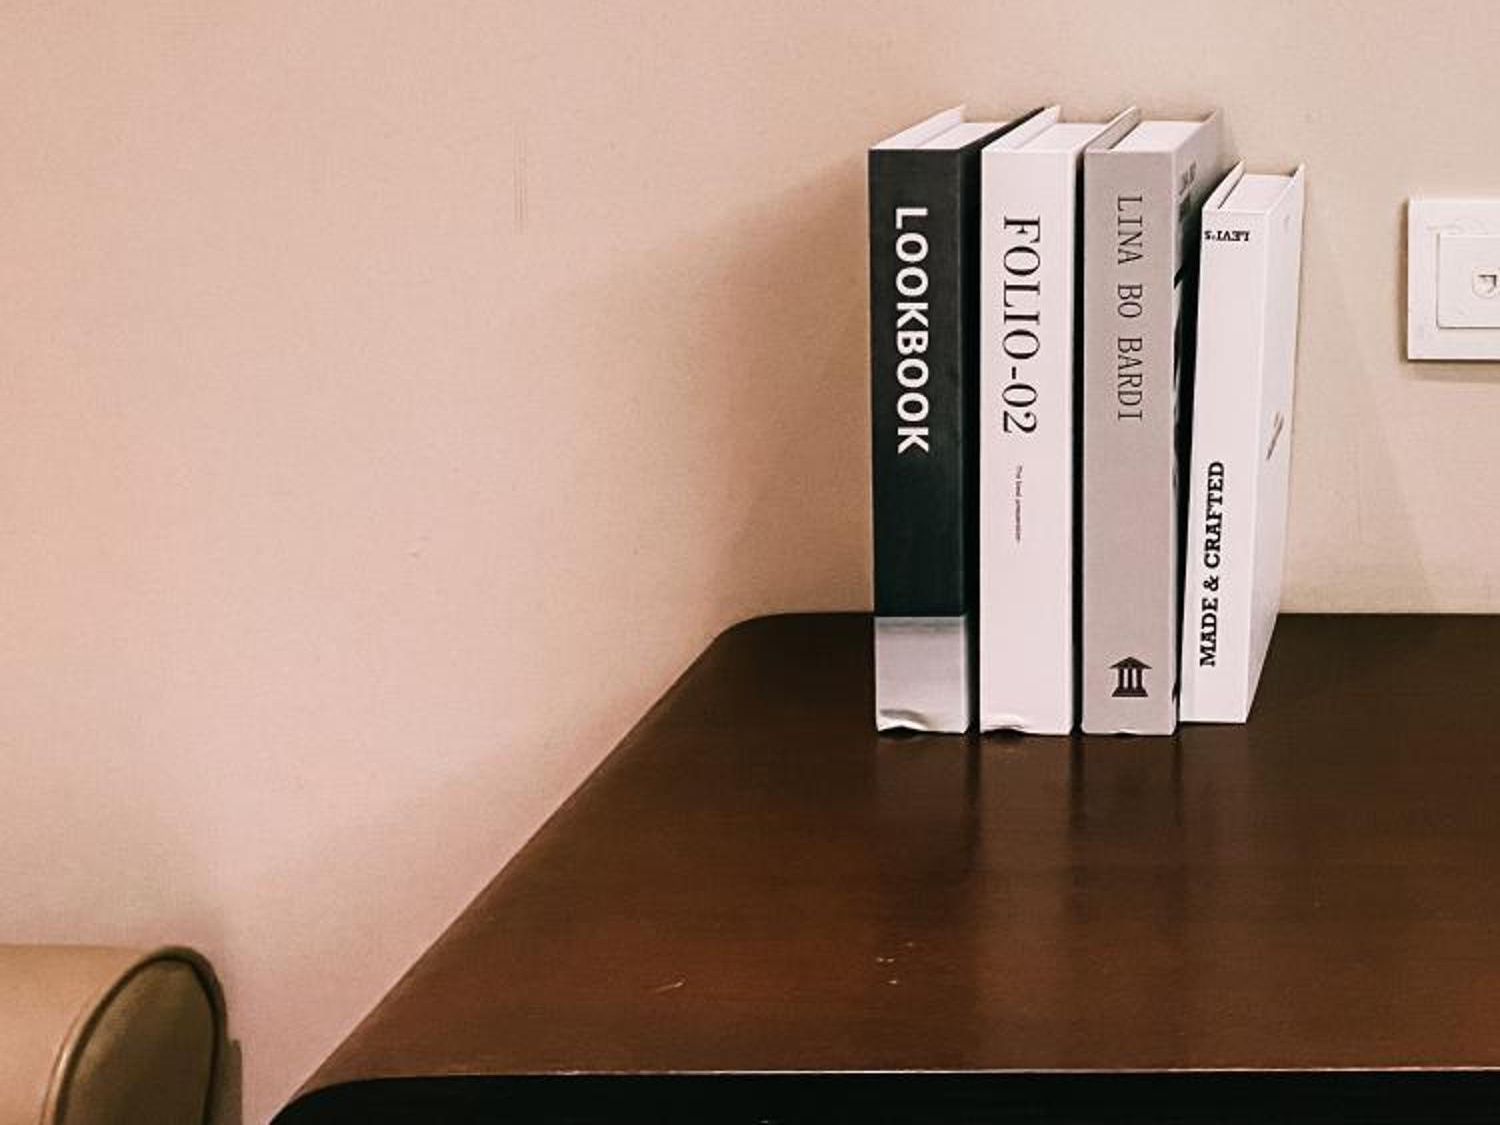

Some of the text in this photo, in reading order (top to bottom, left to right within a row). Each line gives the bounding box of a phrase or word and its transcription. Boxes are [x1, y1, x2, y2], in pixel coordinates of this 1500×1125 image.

[895, 207, 930, 454] LOOKBOOK
[1001, 216, 1041, 434] FOLIO-02
[1117, 195, 1144, 421] LINA BO BARDI
[1199, 461, 1225, 668] MADE & CRAFTED
